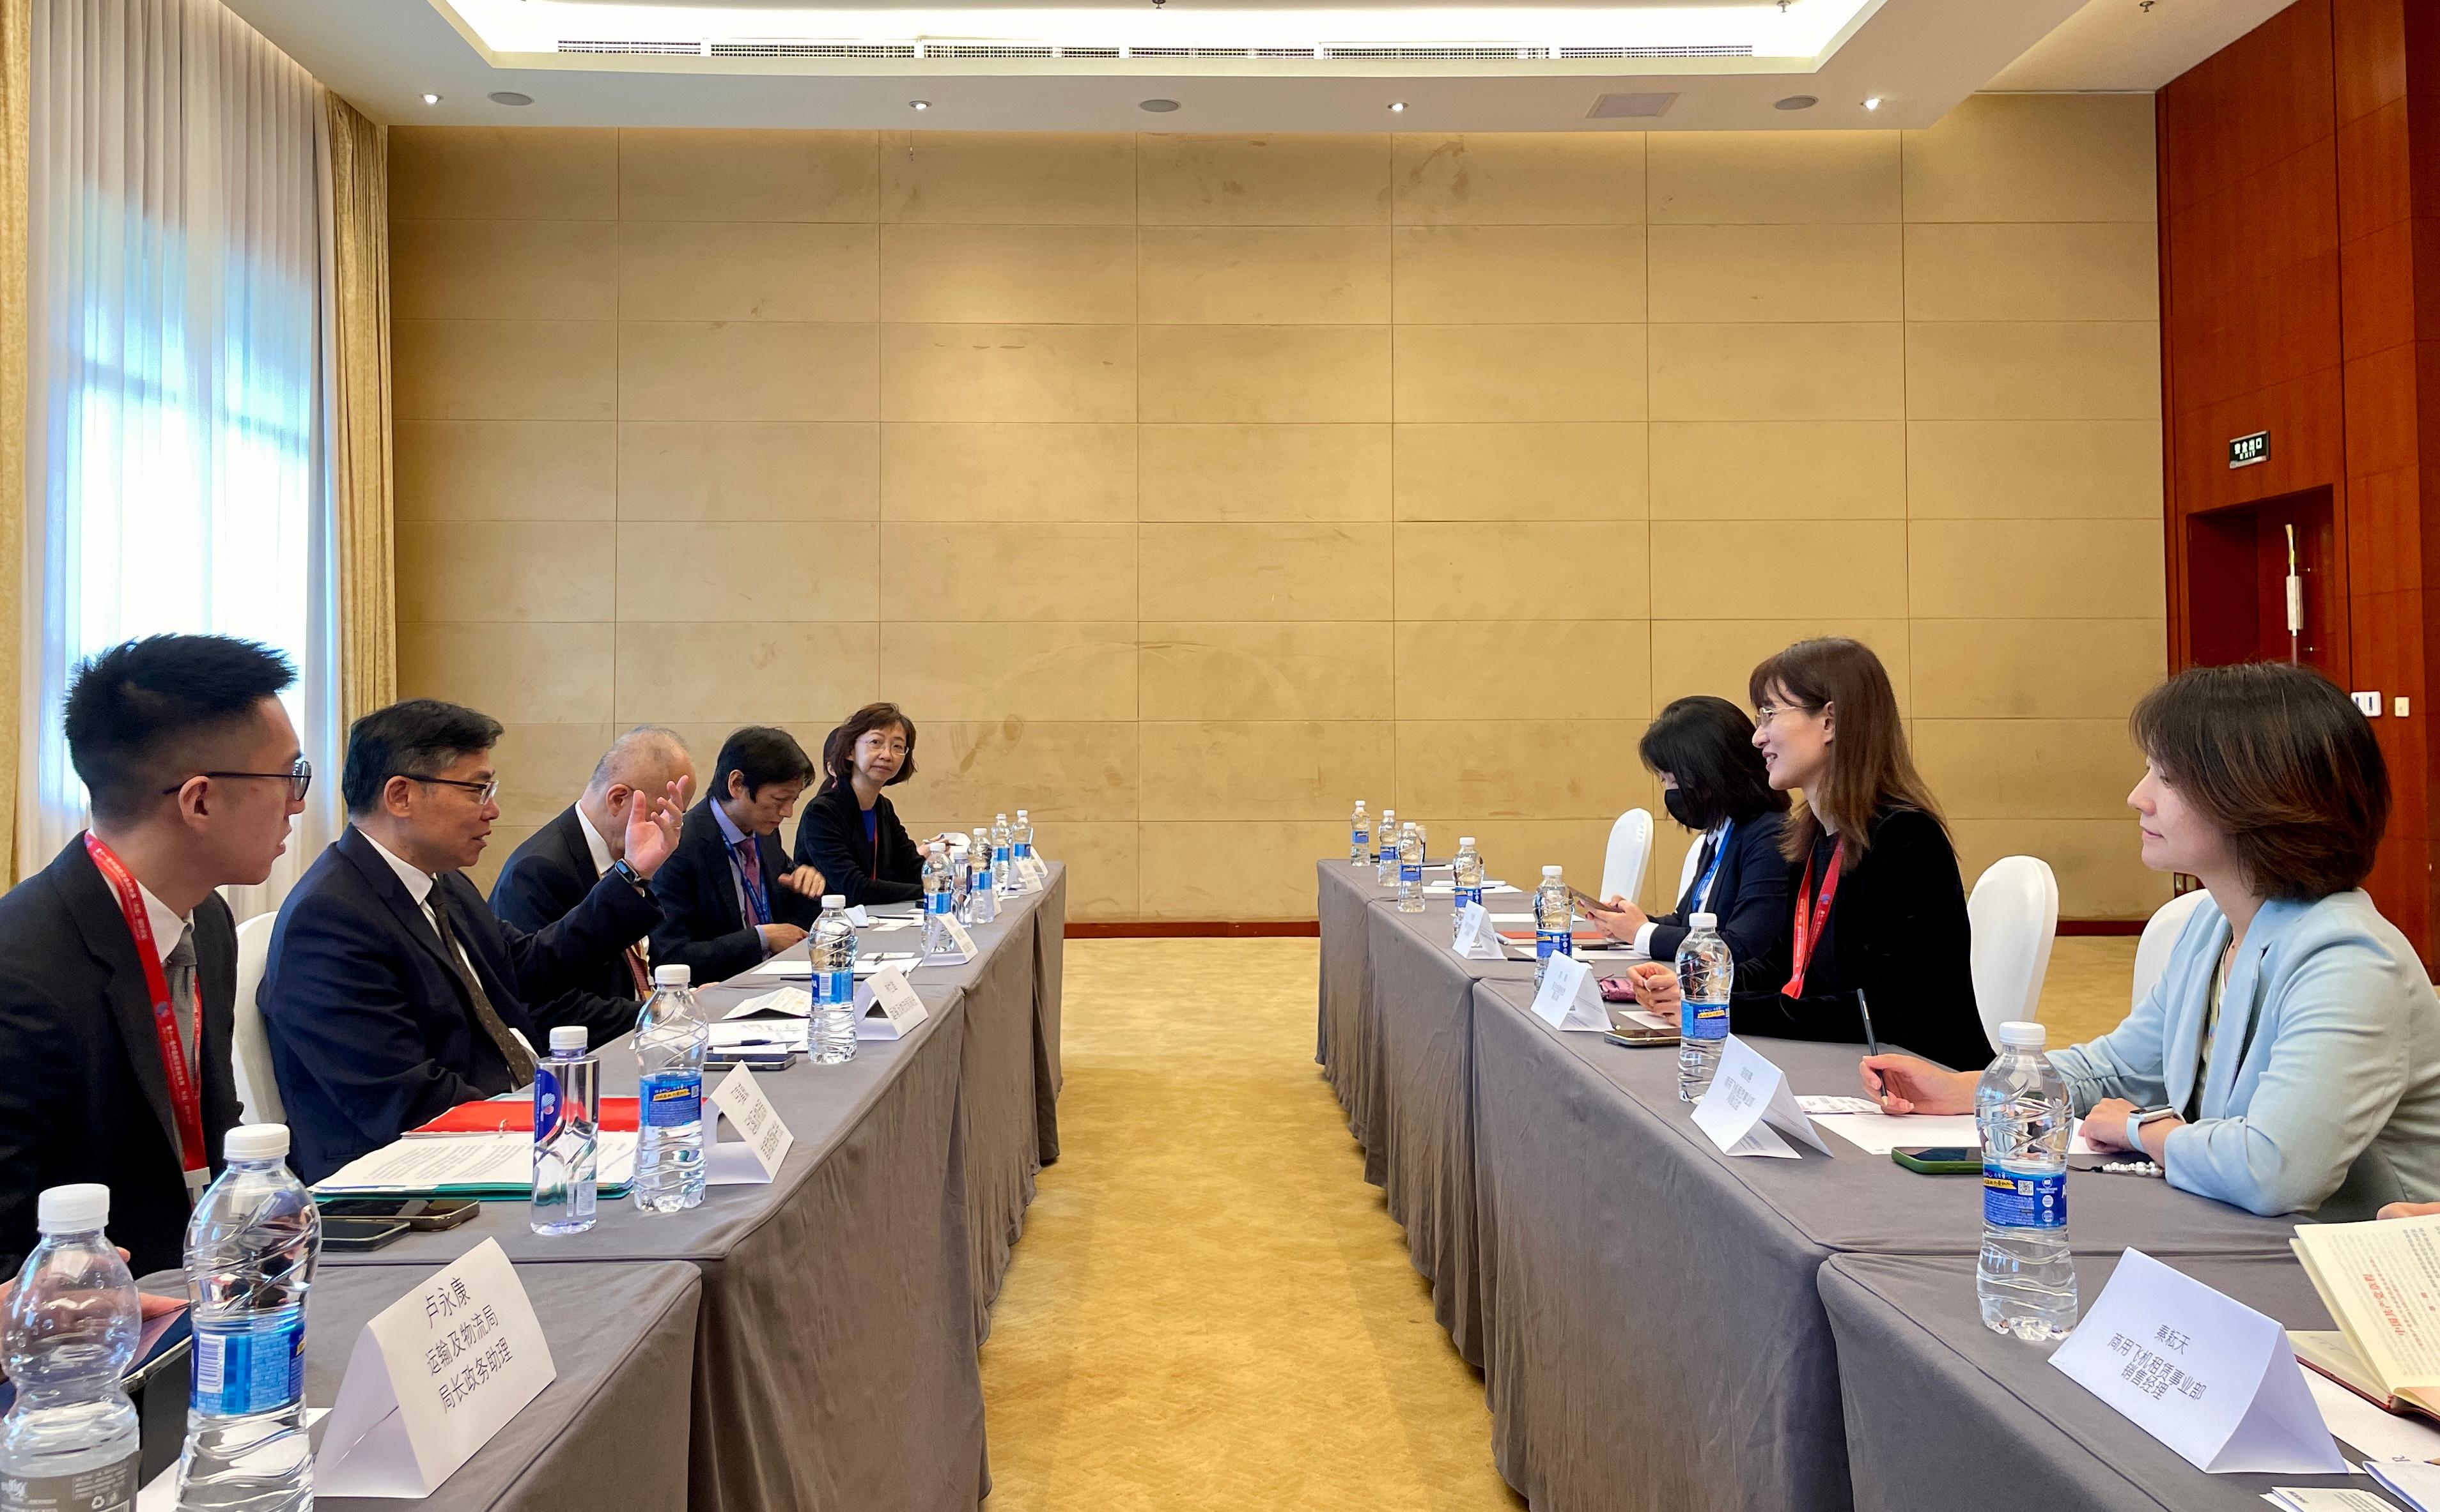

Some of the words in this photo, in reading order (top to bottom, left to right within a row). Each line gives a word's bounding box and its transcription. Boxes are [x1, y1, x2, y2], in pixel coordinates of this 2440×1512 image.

[425, 1277, 470, 1329] 卢永康
[425, 1304, 499, 1376] 运输及物流局
[2107, 1332, 2207, 1400] 商用飞机租赁事业部
[439, 1337, 513, 1414] 局长政务助理
[2121, 1361, 2169, 1400] 销售经理
